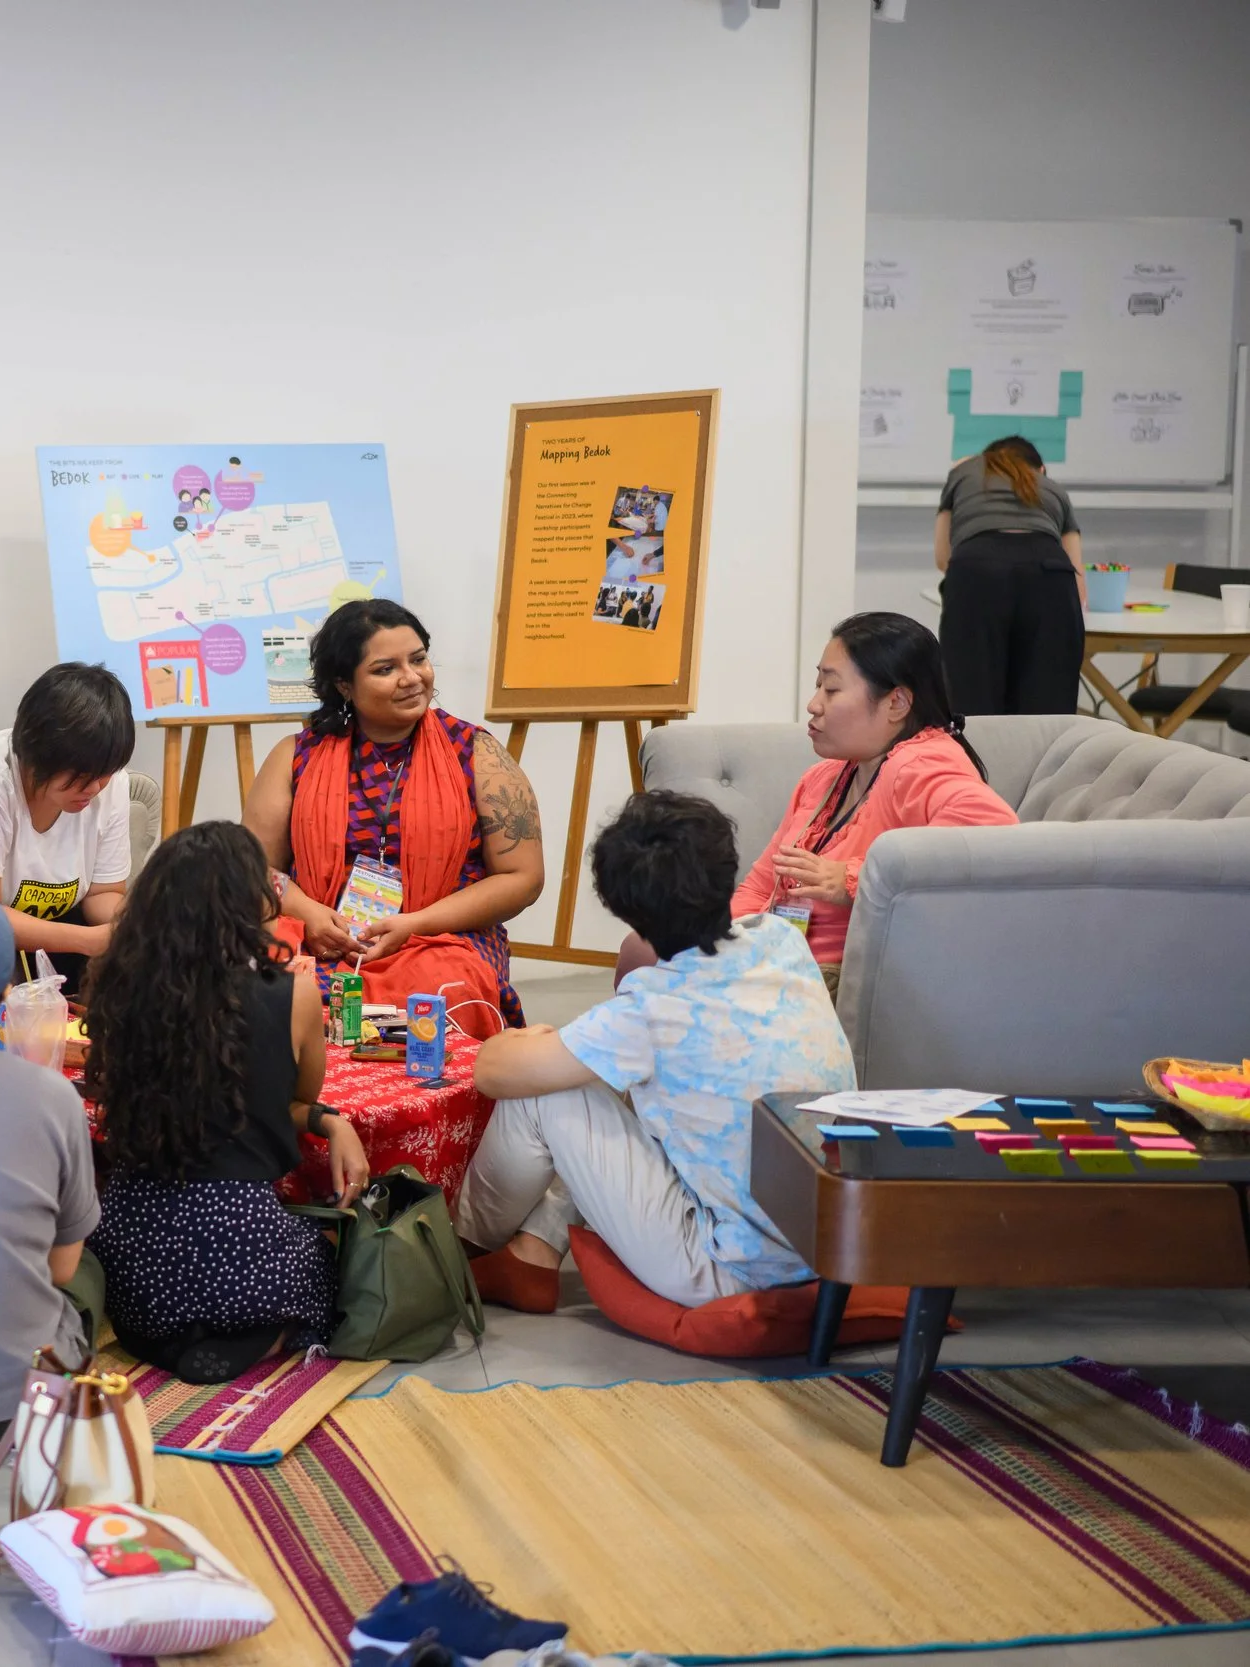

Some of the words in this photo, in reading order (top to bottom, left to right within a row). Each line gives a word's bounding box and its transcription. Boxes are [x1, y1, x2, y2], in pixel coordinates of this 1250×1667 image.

[540, 449, 580, 464] Mapping
[584, 445, 610, 459] Bedok
[50, 470, 91, 487] BEDOK
[354, 868, 376, 880] FESTIVAL
